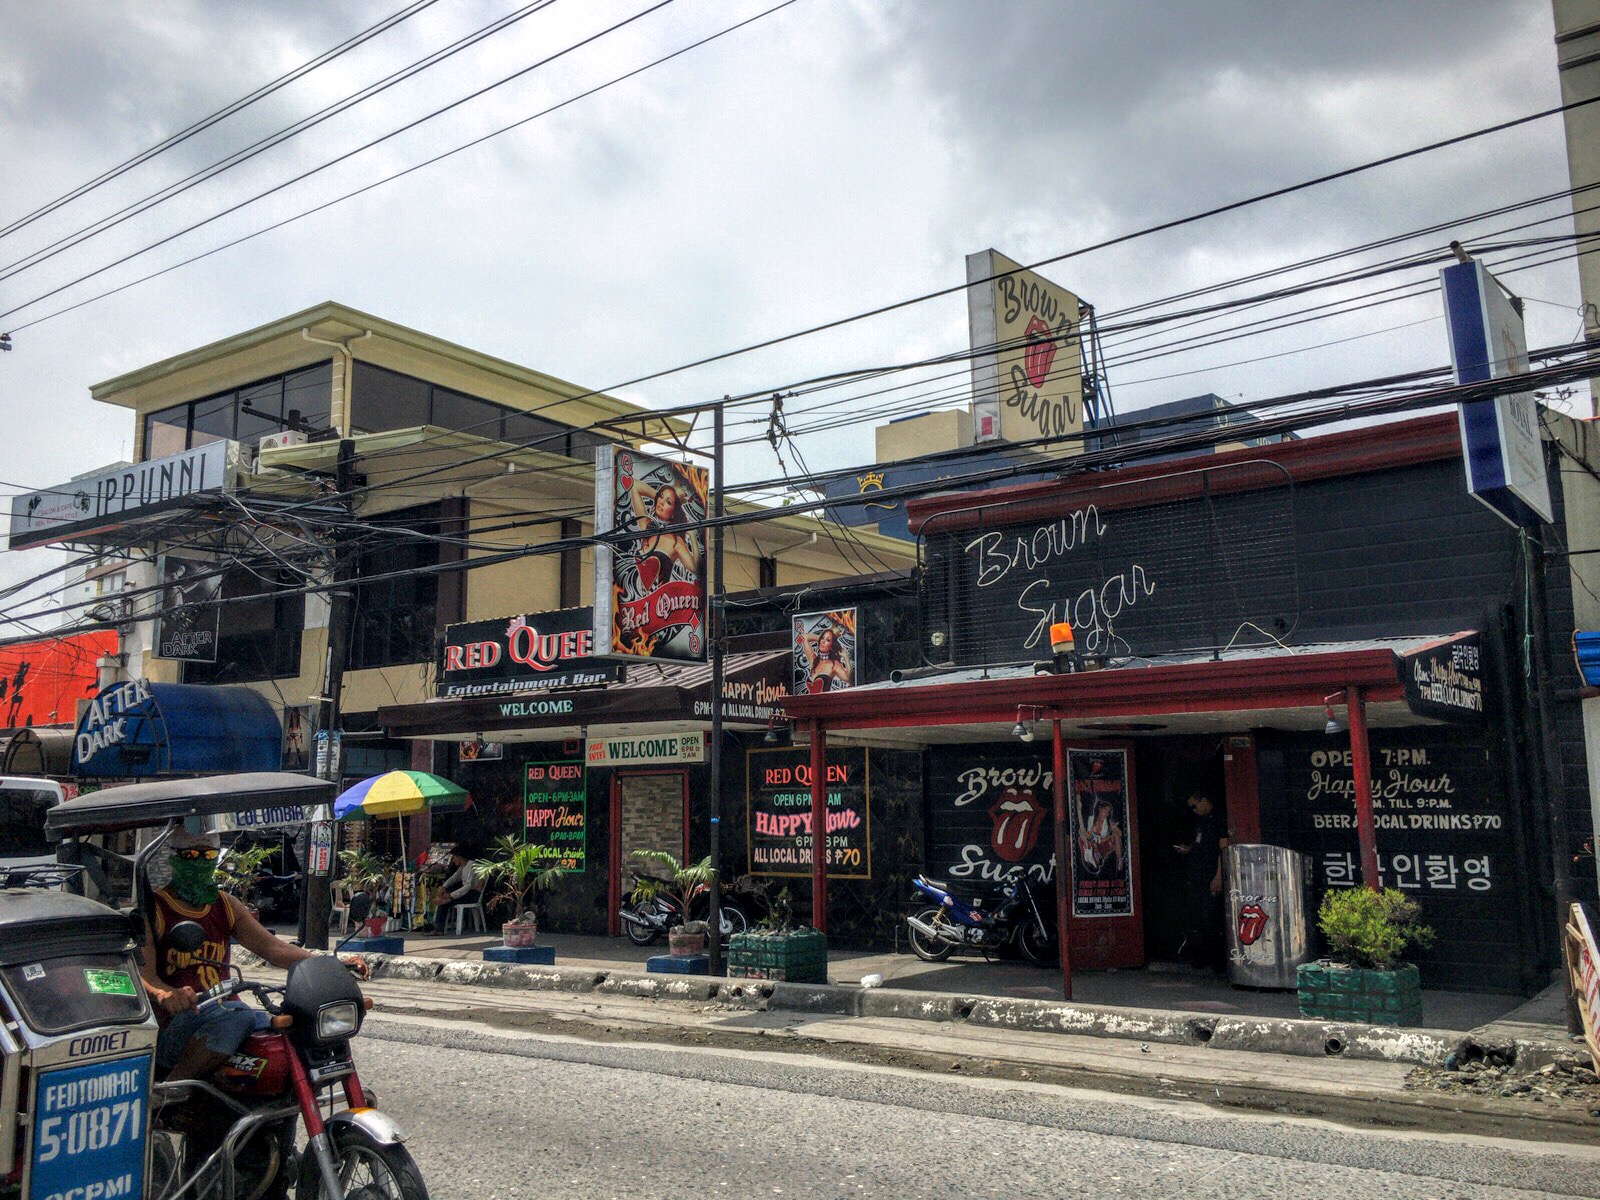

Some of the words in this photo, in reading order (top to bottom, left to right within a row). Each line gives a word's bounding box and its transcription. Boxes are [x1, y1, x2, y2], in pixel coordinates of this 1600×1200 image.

[998, 274, 1078, 347] Brown
[1006, 363, 1077, 450] Sugar
[95, 452, 207, 518] IPPUNNI
[964, 504, 1107, 587] Brown
[621, 600, 650, 632] Red
[655, 592, 699, 620] Queen
[1018, 564, 1155, 652] Sugar
[171, 630, 213, 645] AFTER
[445, 640, 501, 671] RED
[508, 624, 594, 672] QUEE
[162, 642, 199, 657] DARK
[446, 674, 568, 696] Entertainment
[573, 673, 606, 684] Bar
[721, 682, 755, 701] HAPPY
[87, 678, 153, 731] AFTER
[500, 700, 573, 717] WELCOME
[739, 704, 755, 719] LOCAL
[77, 717, 127, 764] DARK
[608, 739, 678, 760] WELCOME
[681, 737, 699, 745] OPEN
[1311, 750, 1352, 768] OPE
[528, 767, 545, 780] RED
[548, 765, 582, 780] QUEEN
[765, 768, 791, 784] RED
[1383, 768, 1456, 800] Hour
[773, 794, 795, 806] OPEN
[1390, 799, 1414, 809] TILL
[526, 809, 557, 828] HAPPY
[556, 805, 585, 828] Hour
[755, 811, 813, 837] HAPPY
[1313, 814, 1350, 829] BEER
[1373, 814, 1408, 830] OCAL
[1408, 814, 1474, 830] DRINKS
[754, 848, 768, 864] ALL
[769, 848, 797, 864] LOCAL
[69, 1031, 130, 1057] COMET
